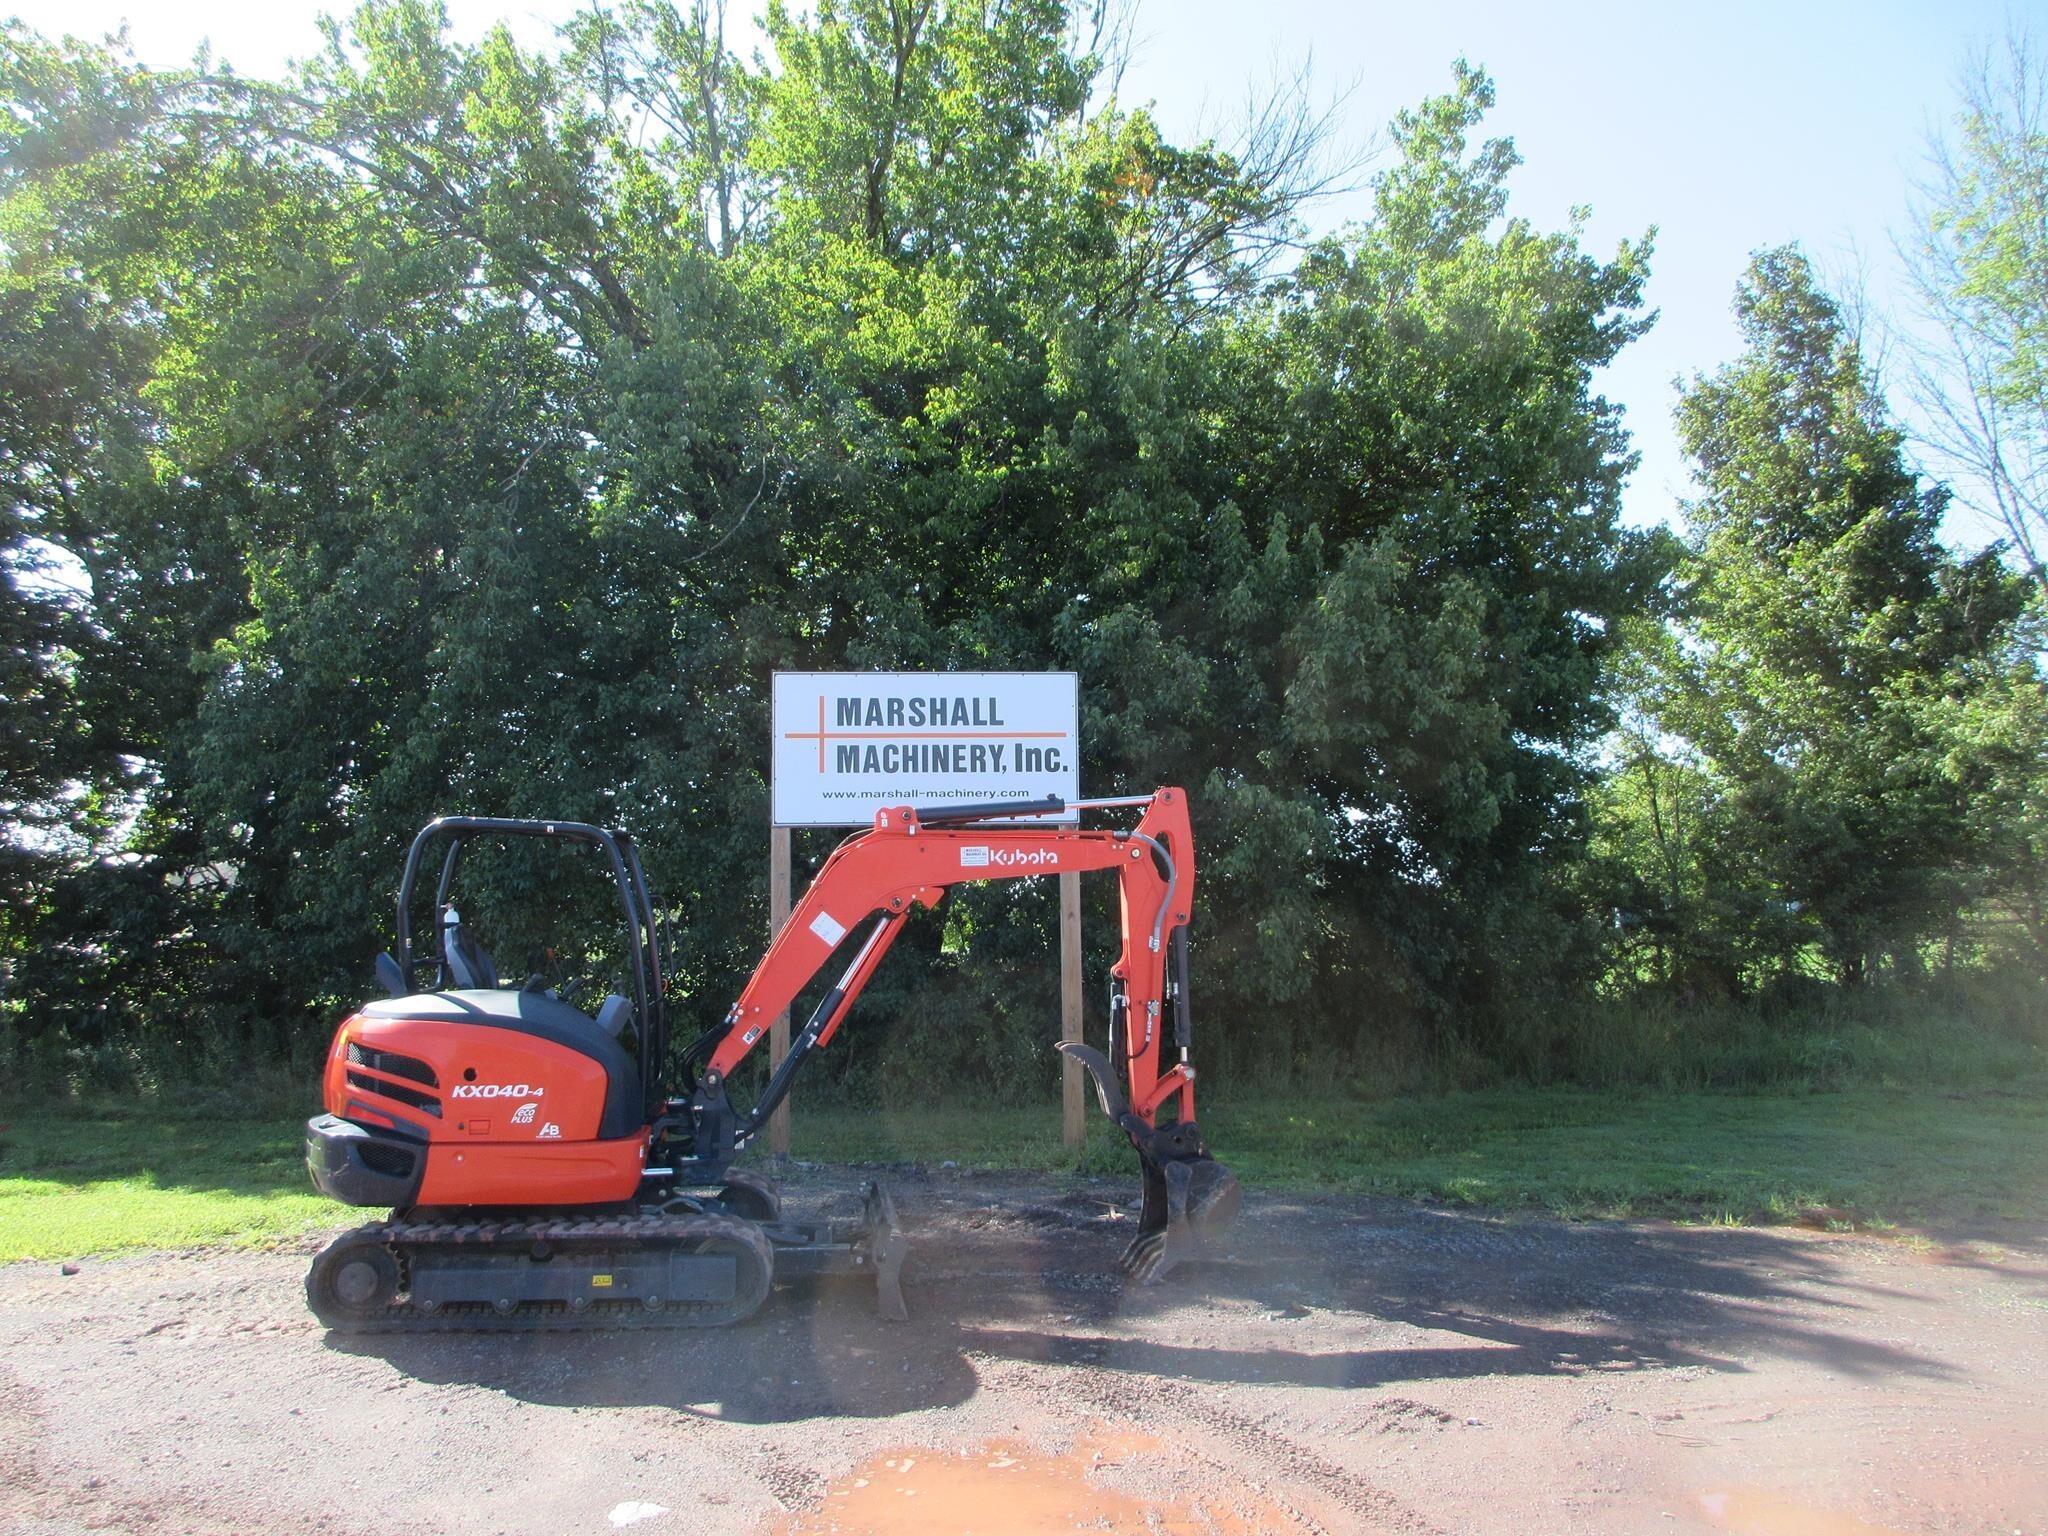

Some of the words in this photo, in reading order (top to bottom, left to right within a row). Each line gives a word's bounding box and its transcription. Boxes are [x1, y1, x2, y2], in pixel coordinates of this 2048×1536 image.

[837, 697, 1004, 727] MARSHALL
[837, 743, 1007, 775] MACHINERY,
[1014, 742, 1069, 773] Inc.
[822, 788, 1030, 799] www.marshall-machinery.com
[990, 848, 1058, 866] Kubota
[452, 1084, 544, 1098] KX040-4
[510, 1116, 534, 1124] PLUS
